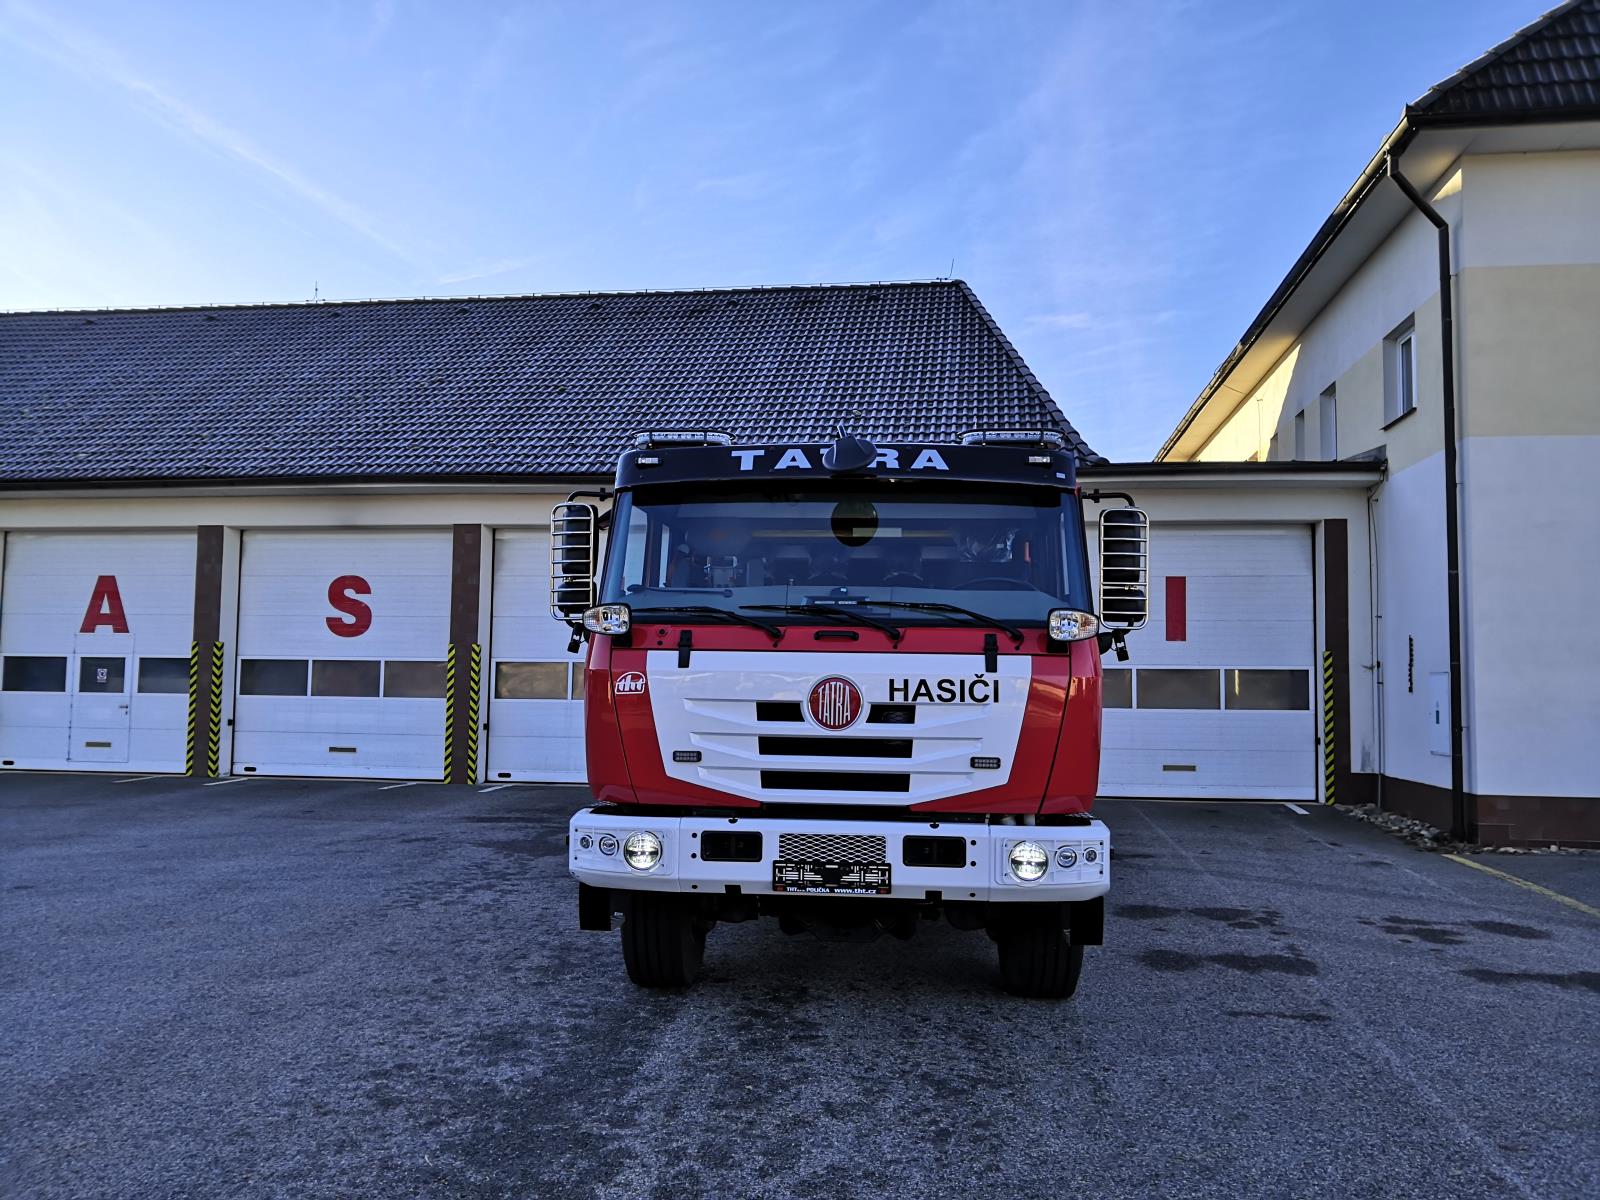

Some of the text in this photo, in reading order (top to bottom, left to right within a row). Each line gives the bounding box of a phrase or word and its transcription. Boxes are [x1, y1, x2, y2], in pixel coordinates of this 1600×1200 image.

[731, 448, 950, 471] TARA
[80, 575, 130, 634] A
[325, 574, 373, 638] S
[817, 681, 850, 726] TATRA
[888, 673, 1000, 703] HASIČI
